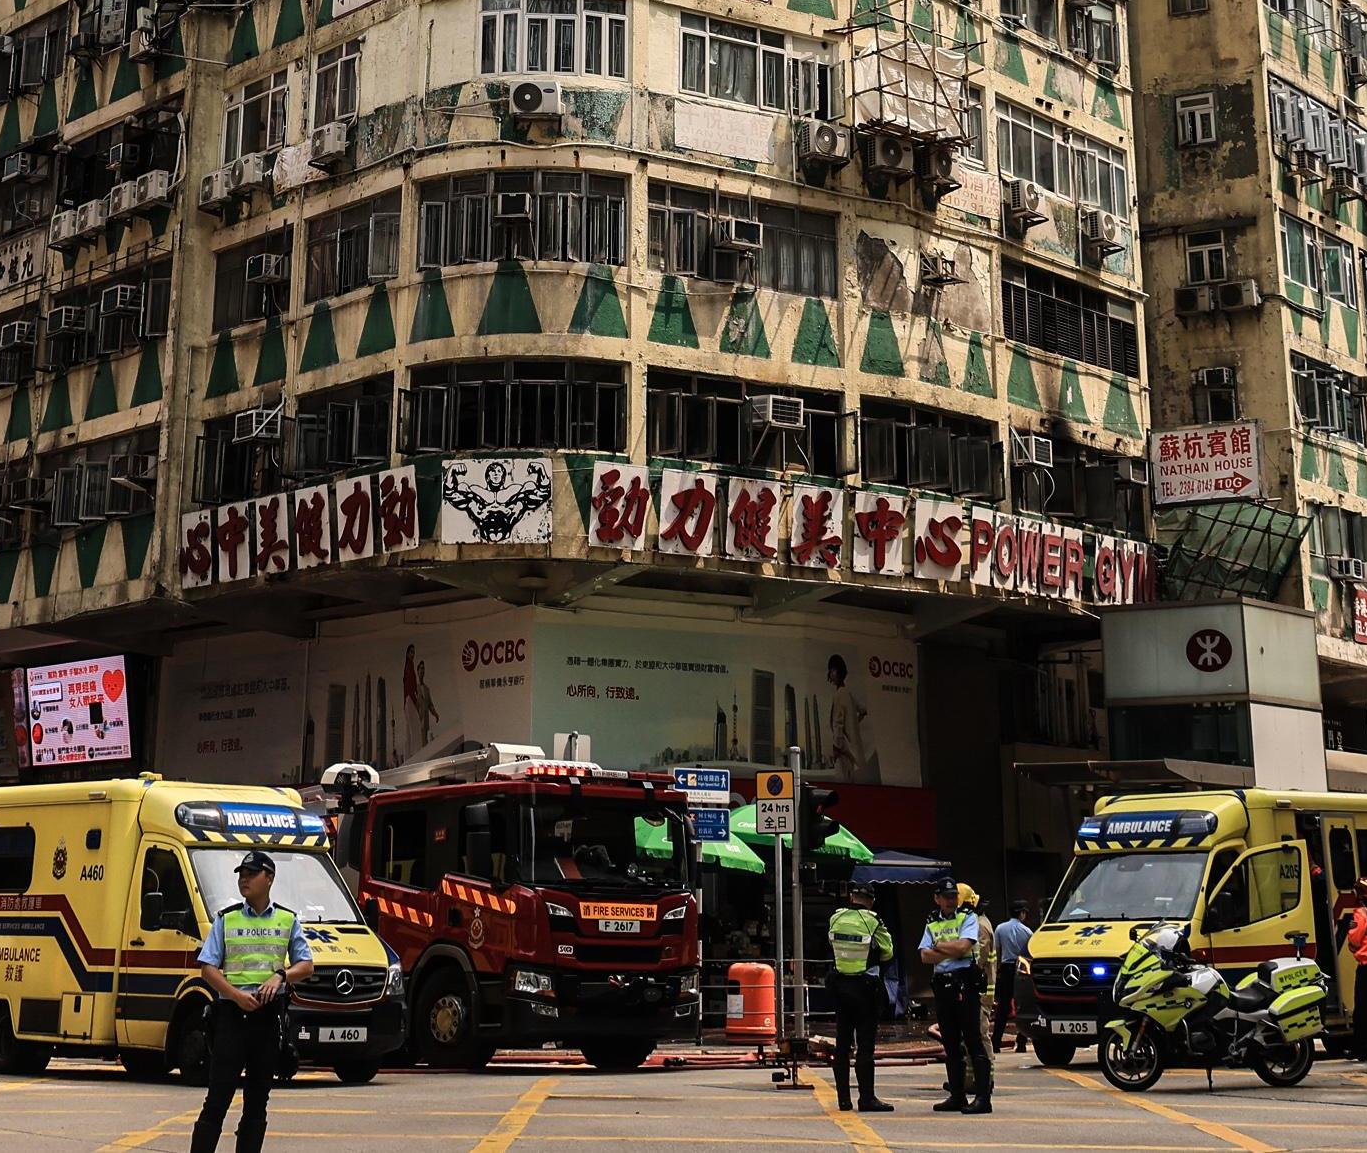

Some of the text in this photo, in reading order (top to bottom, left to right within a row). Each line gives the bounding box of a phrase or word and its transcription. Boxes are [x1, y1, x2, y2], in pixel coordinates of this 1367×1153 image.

[1159, 427, 1251, 463] 蘇杭賓館
[1160, 457, 1253, 477] NATHAN HOUSE
[1179, 481, 1195, 495] 2384
[1197, 479, 1213, 494] 0143
[1217, 477, 1243, 489] 10G
[970, 518, 1084, 591] POWER
[480, 638, 526, 665] OCBC
[882, 660, 914, 679] OCBC
[761, 803, 790, 813] 24 hrs
[227, 812, 297, 828] AMBULANCE
[764, 816, 787, 830] 全日
[1106, 819, 1173, 835] AMBULANCE
[79, 864, 104, 881] A460
[593, 906, 610, 916] FIRE
[610, 906, 645, 917] SERVICES
[246, 928, 271, 936] POLICE
[604, 921, 634, 931] F 2617
[328, 1029, 359, 1040] A 460
[1059, 1022, 1088, 1033] A 205
